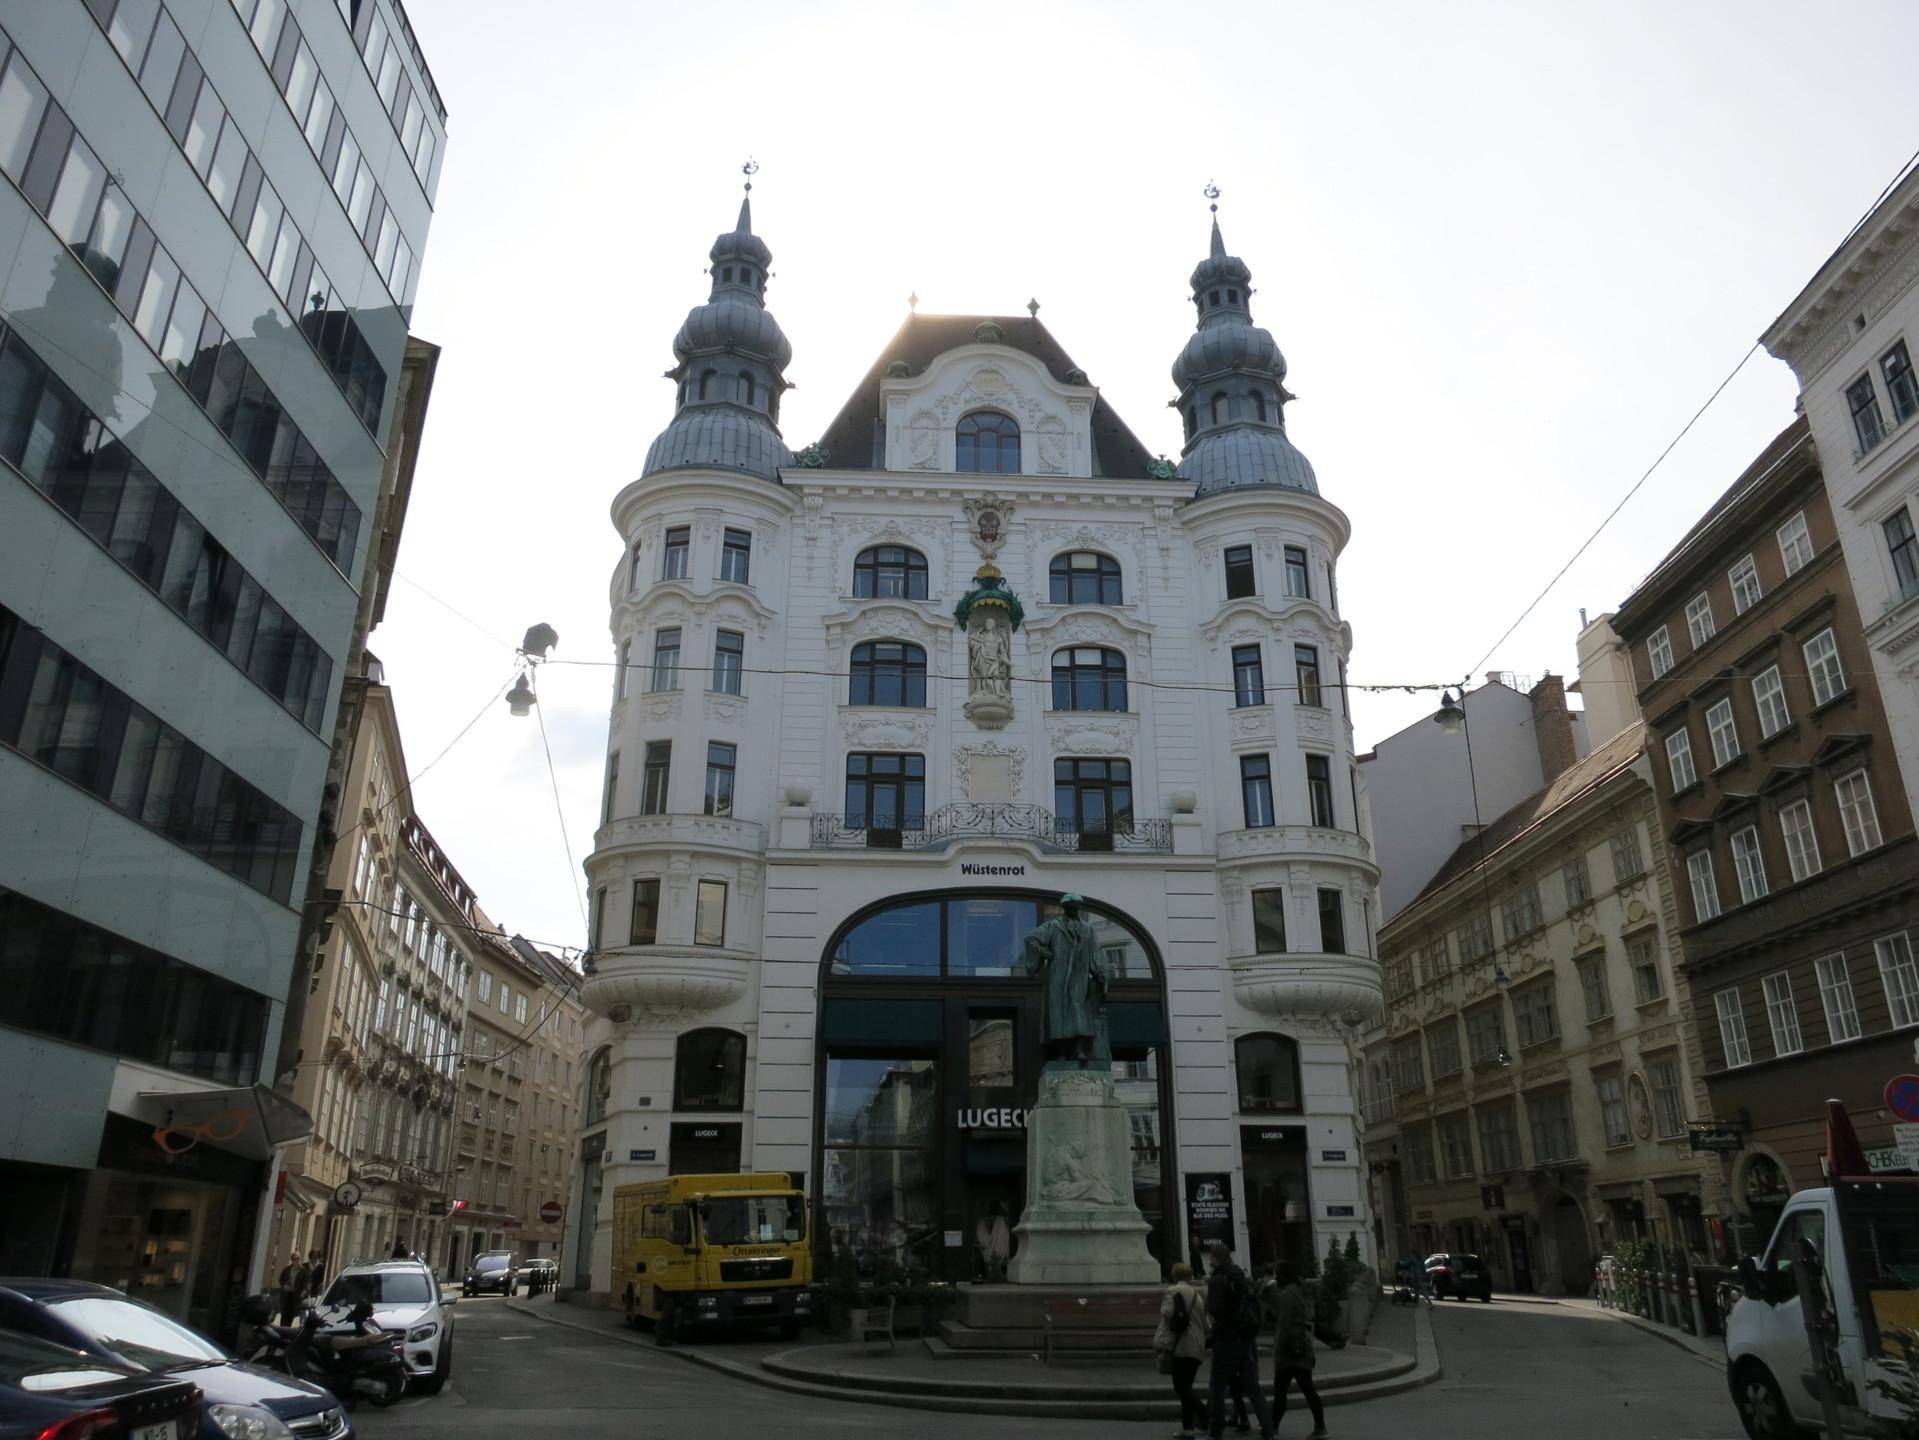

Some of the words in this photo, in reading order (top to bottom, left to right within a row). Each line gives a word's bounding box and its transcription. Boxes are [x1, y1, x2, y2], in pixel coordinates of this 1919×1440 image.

[961, 864, 1025, 875] Wüstenrot
[694, 1129, 719, 1137] LUGECK
[733, 1246, 781, 1257] Ottakringer
